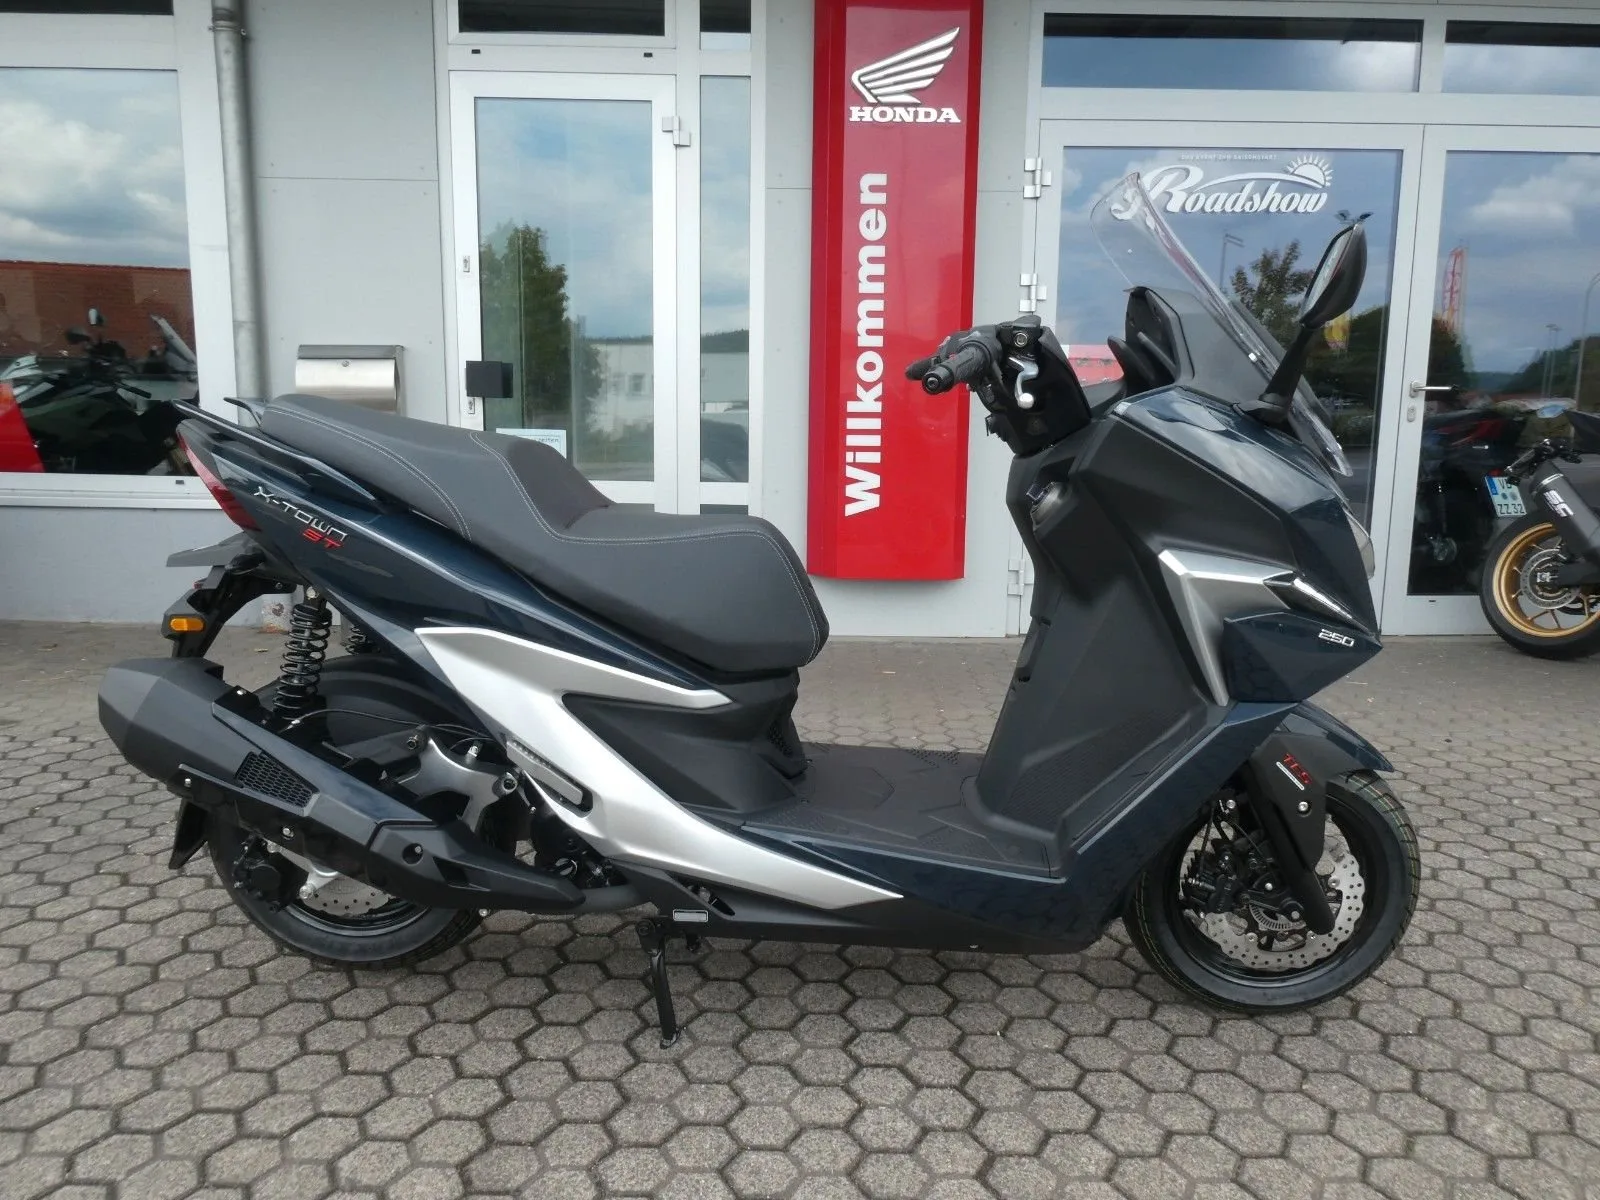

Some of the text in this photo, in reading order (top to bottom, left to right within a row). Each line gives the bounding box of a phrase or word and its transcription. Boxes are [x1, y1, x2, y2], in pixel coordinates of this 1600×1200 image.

[849, 106, 961, 123] HONDA
[1110, 164, 1328, 220] Roadshow
[844, 172, 887, 517] Willkommen
[1318, 628, 1355, 647] 250
